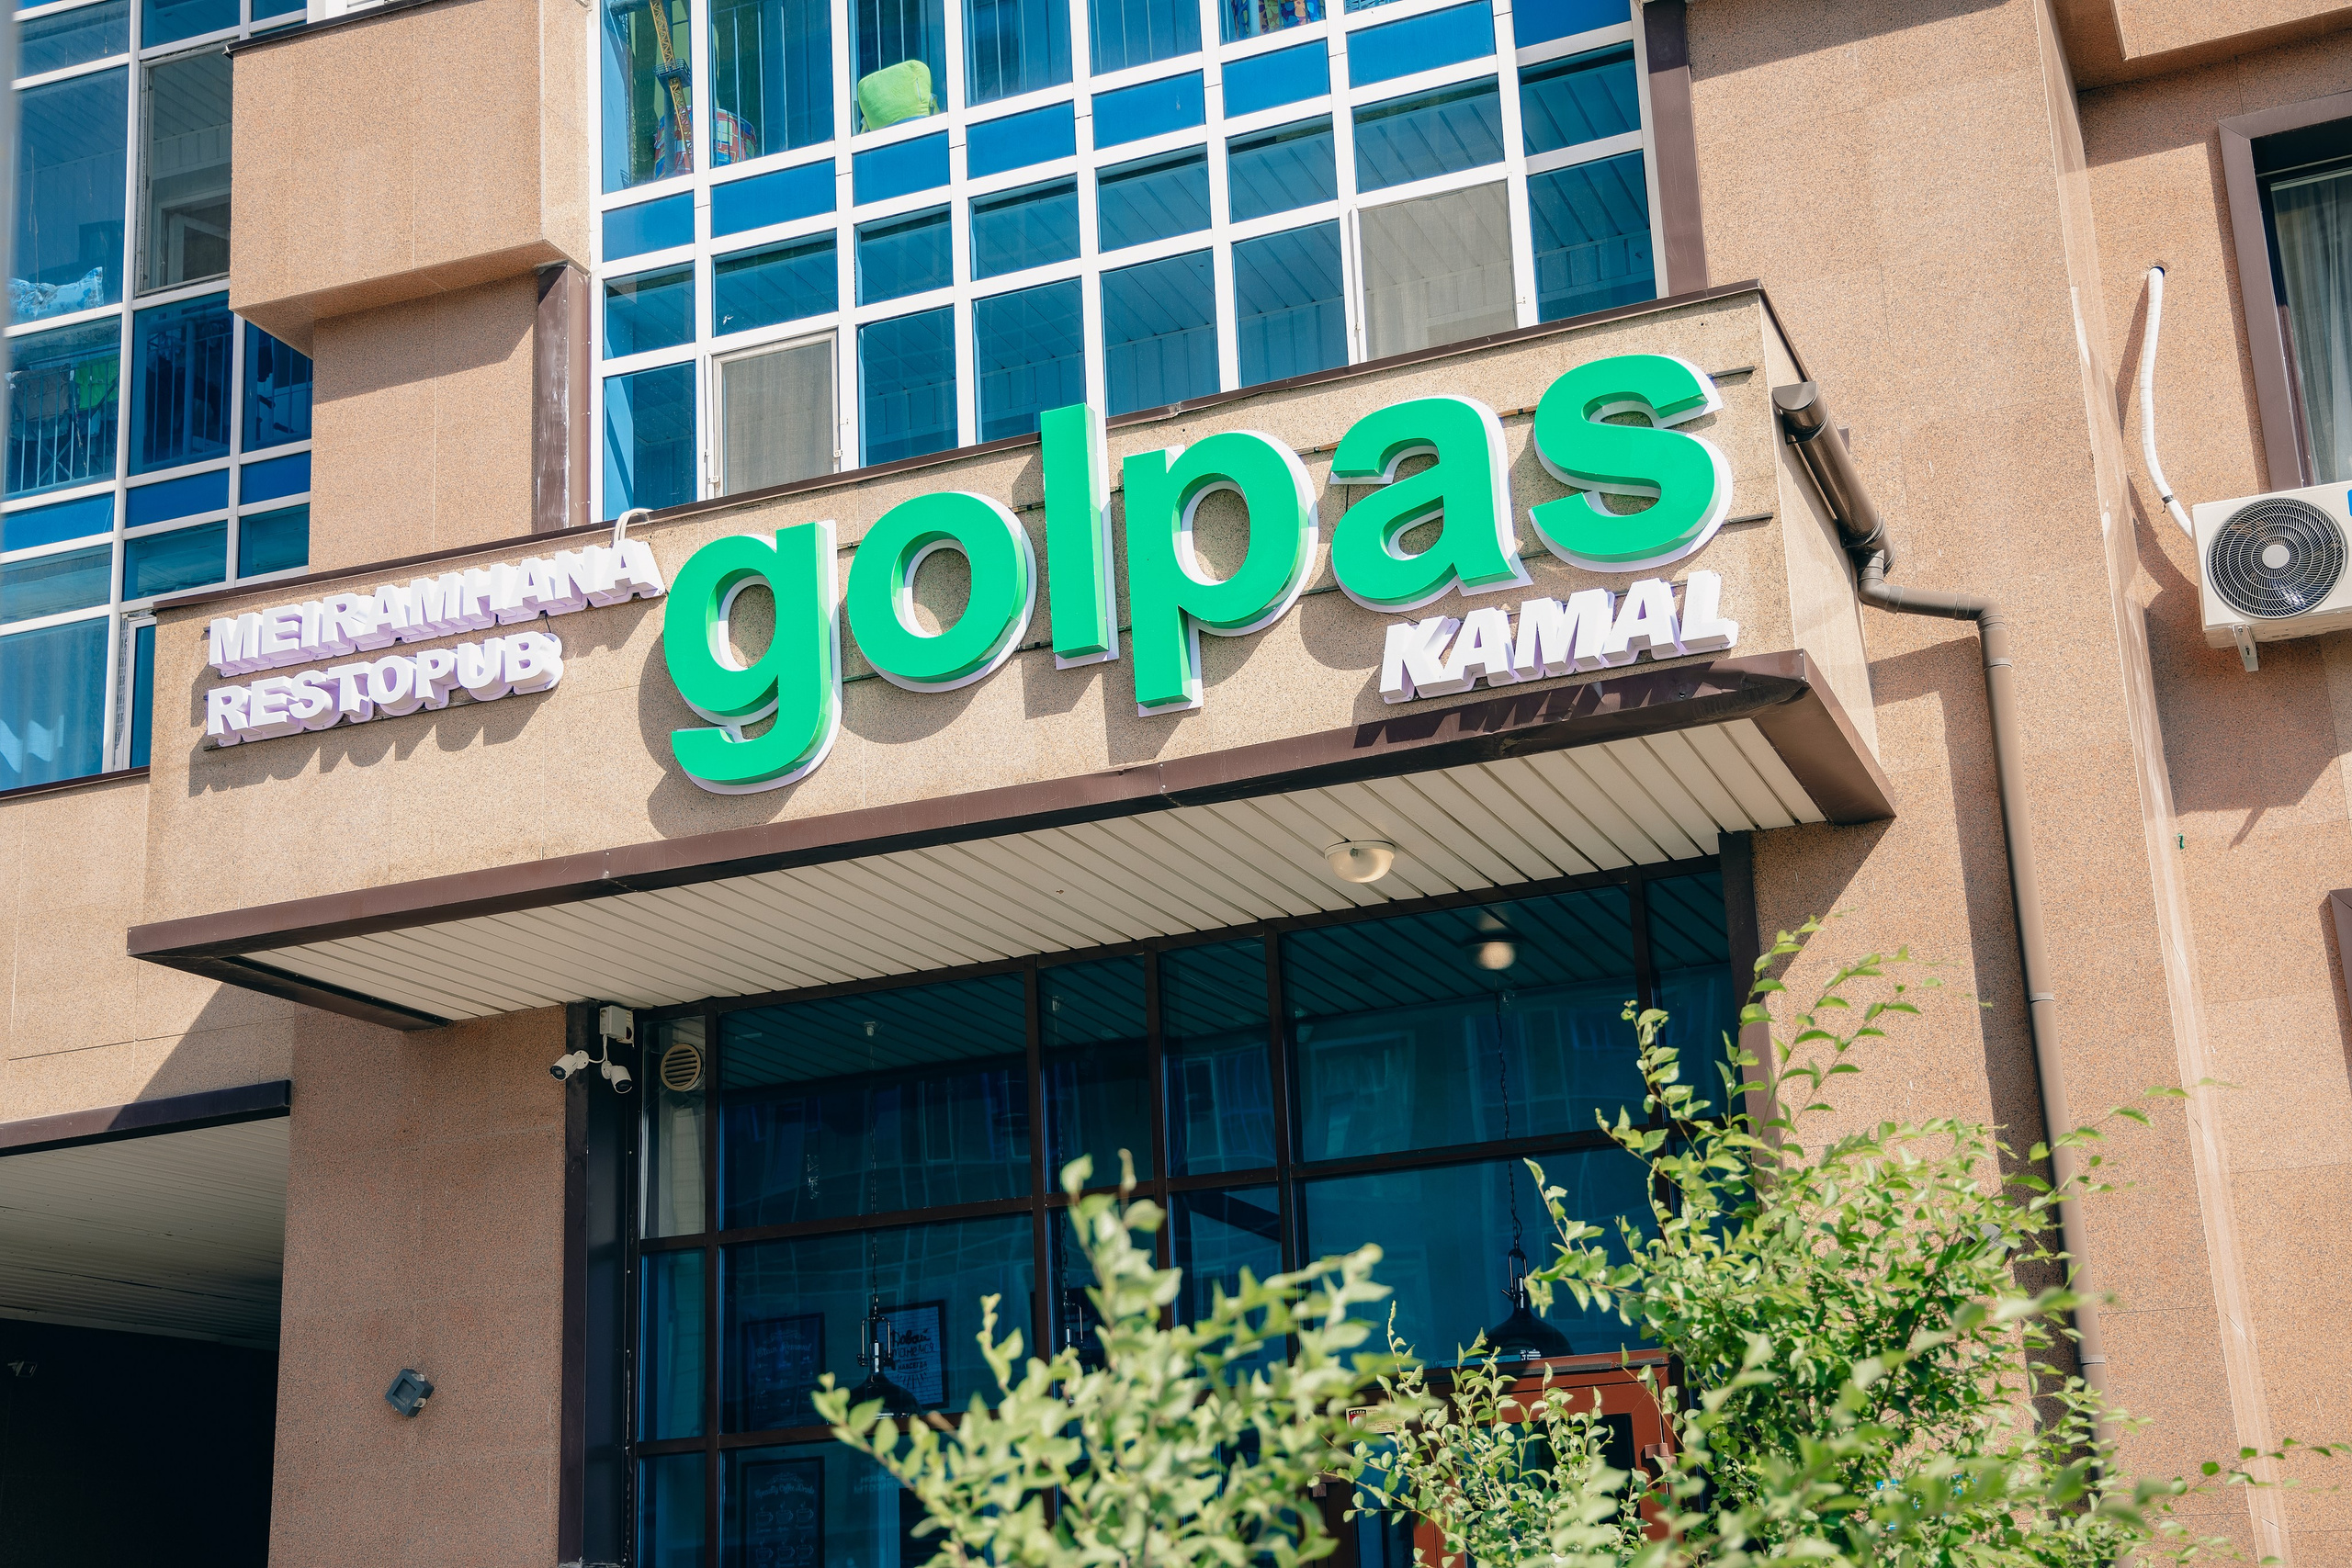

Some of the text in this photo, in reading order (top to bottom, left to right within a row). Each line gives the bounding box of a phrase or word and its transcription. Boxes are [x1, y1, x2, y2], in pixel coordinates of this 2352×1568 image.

[209, 538, 665, 677] MEIRAMHANA
[663, 353, 1735, 795] golpas
[1380, 570, 1739, 704] KAMAL
[207, 631, 563, 747] RESTOPUB
